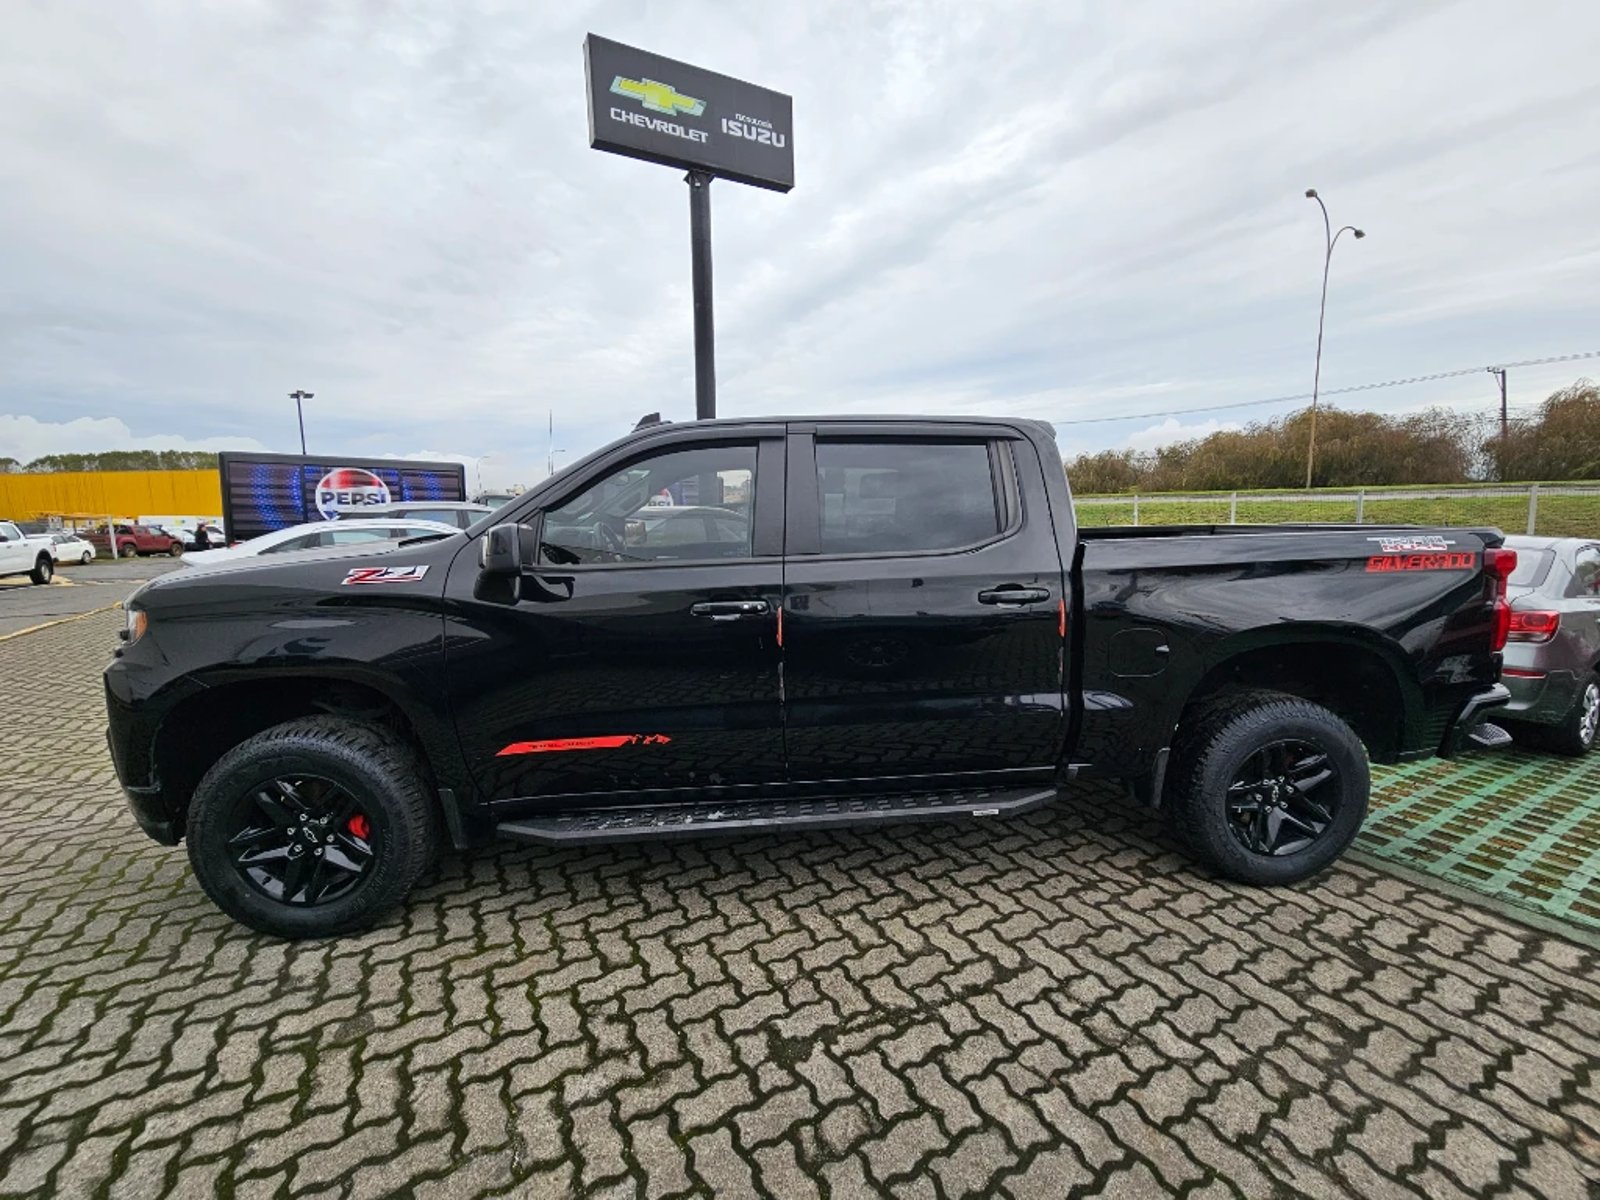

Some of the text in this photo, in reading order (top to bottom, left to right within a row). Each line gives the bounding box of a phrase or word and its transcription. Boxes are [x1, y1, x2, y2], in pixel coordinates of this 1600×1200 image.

[610, 107, 709, 143] CHEVROLET
[721, 118, 785, 148] ISUZU
[320, 491, 387, 506] PEPSI
[1366, 552, 1476, 572] SILVERADO
